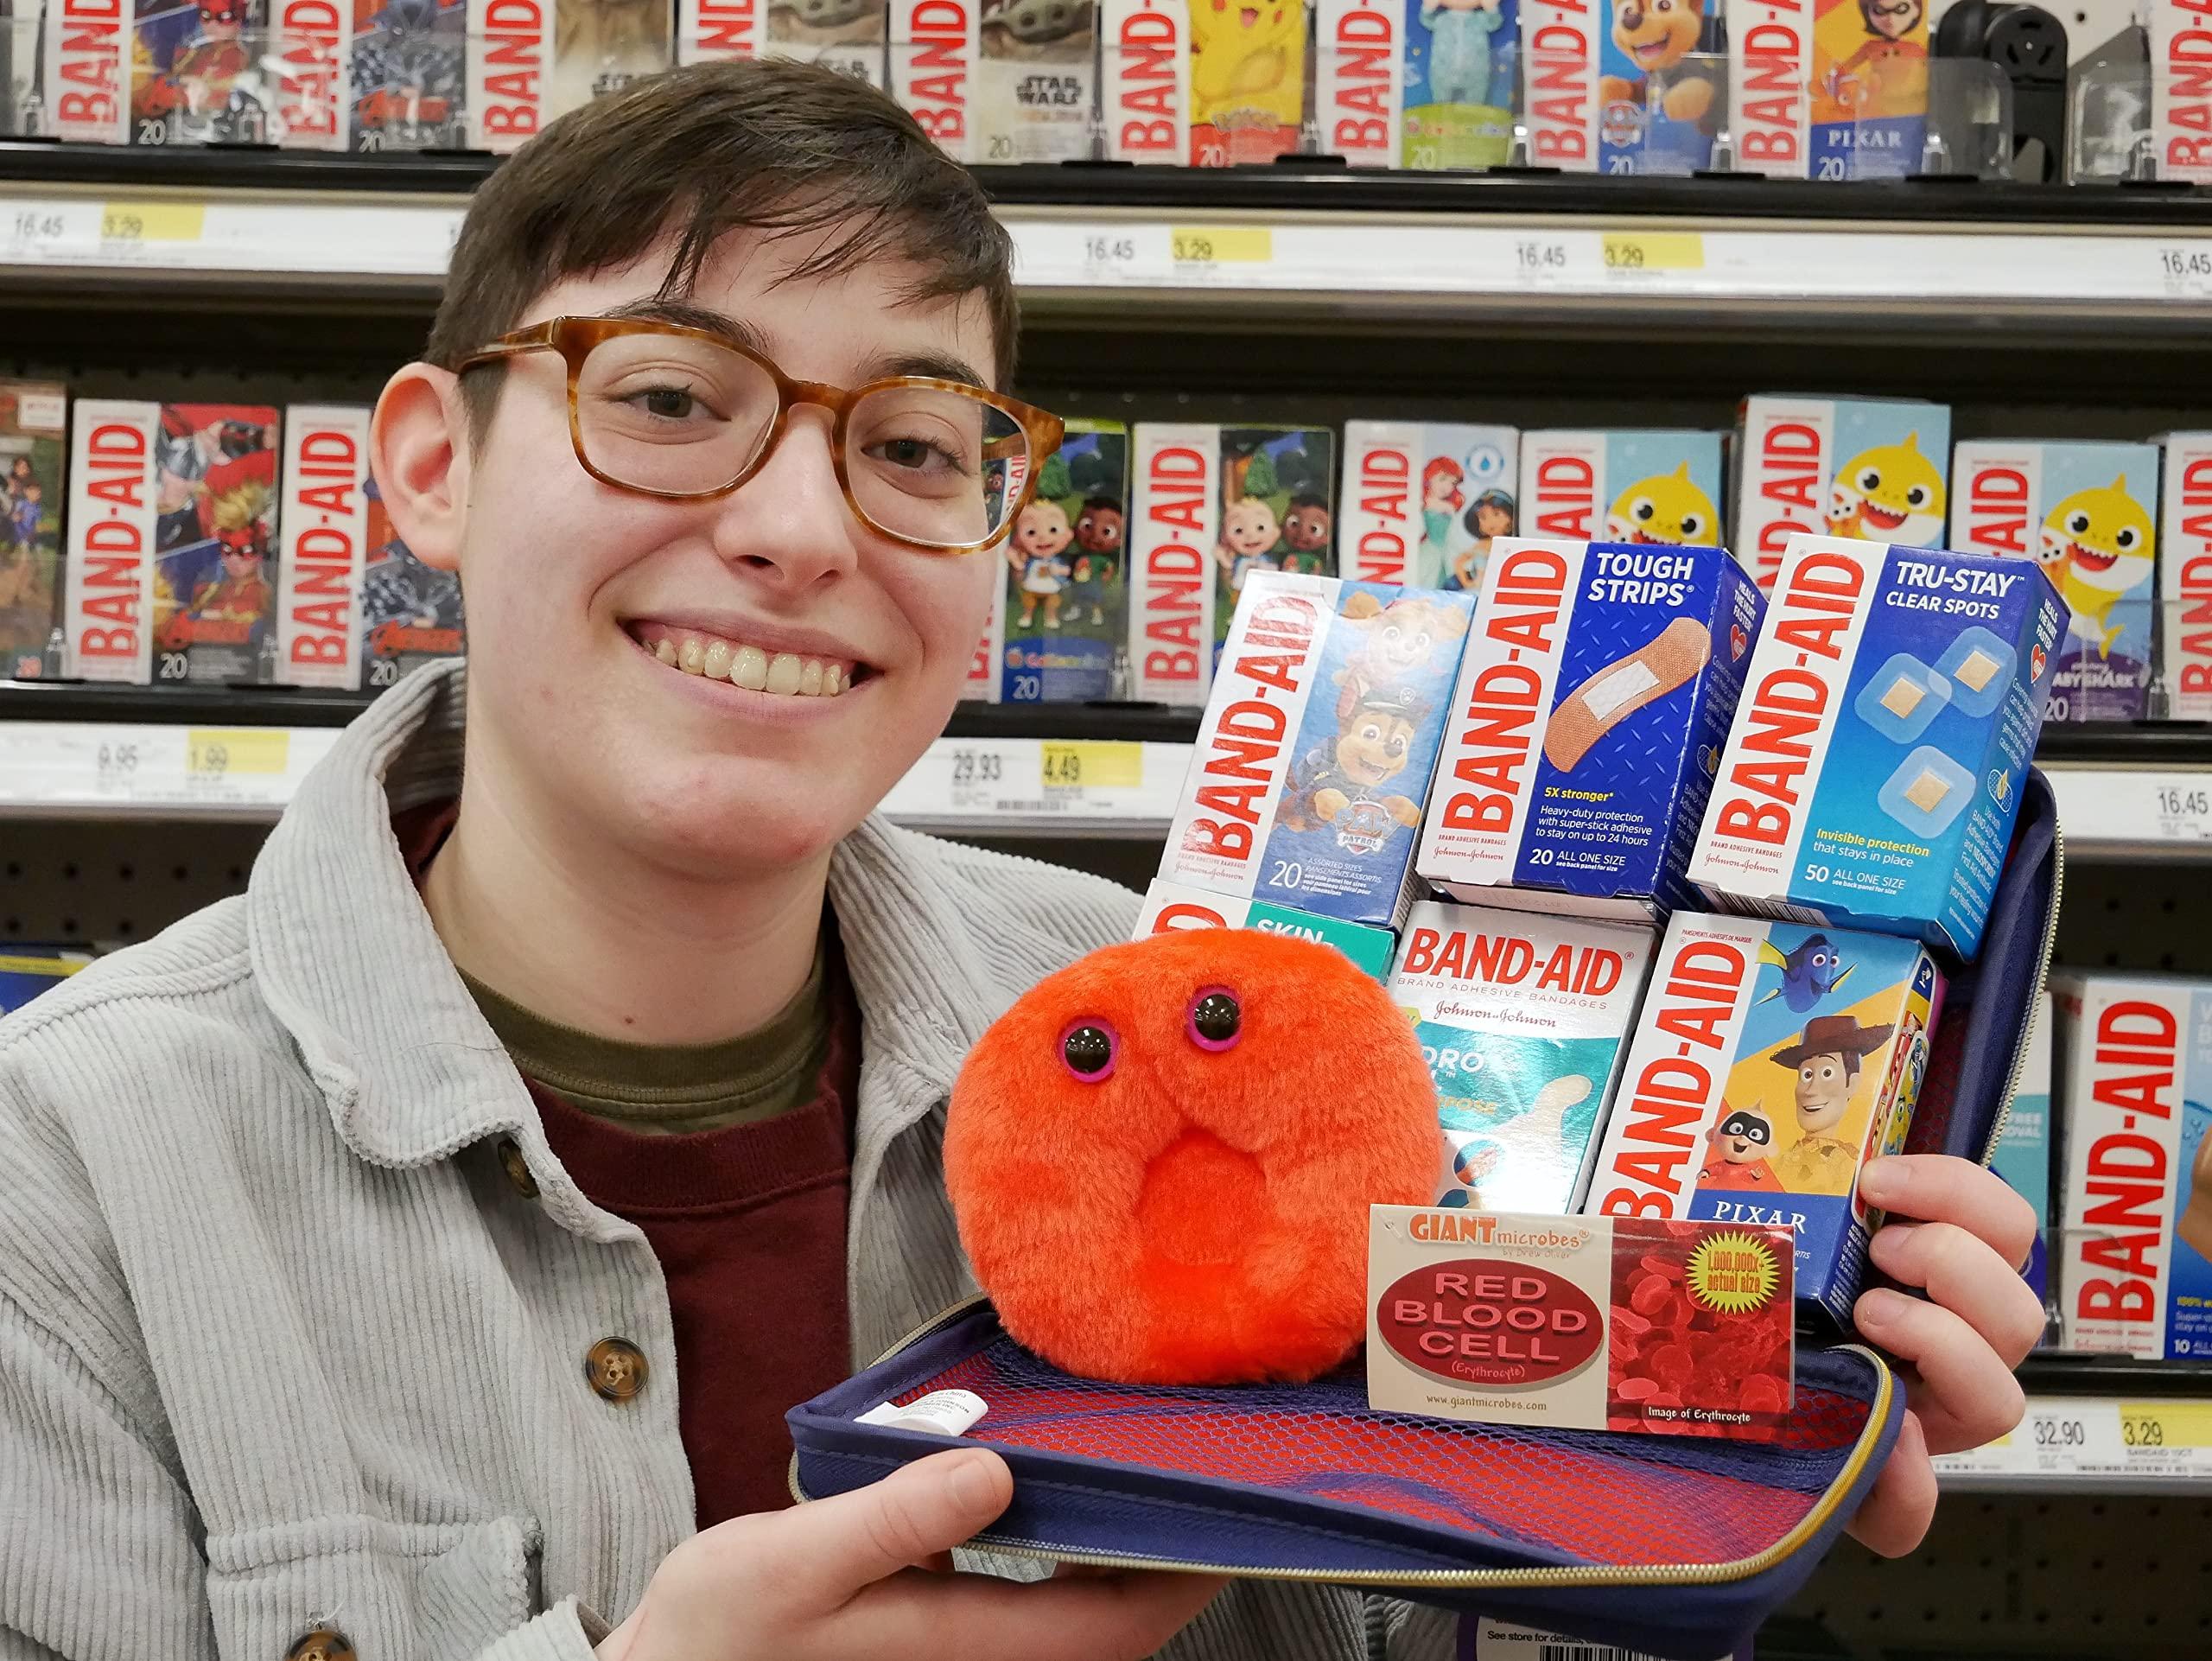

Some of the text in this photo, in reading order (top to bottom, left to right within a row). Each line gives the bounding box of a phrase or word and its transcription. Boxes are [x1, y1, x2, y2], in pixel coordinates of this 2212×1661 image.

[59, 0, 122, 124] BAND
[279, 1, 340, 137] BAND
[484, 1, 543, 136] BAND
[906, 0, 966, 139] BAND
[1120, 0, 1176, 150] BAND-
[1335, 0, 1393, 150] BAND-
[138, 119, 166, 145] 20
[1828, 129, 1903, 149] PIXAR
[1818, 156, 1843, 181] 20
[15, 213, 64, 239] 16.45
[103, 215, 143, 239] 3.29
[1086, 239, 1135, 261] 16.45
[1174, 242, 1213, 261] 3.29
[1517, 244, 1566, 268] 16.45
[1605, 246, 1644, 269] 3.29
[2163, 254, 2212, 275] 16.45
[80, 423, 148, 658] BAND-AID
[290, 432, 356, 665] BAND-AID
[1144, 447, 1206, 681] BAND-AID
[1596, 552, 1695, 581] TOUGH
[1885, 590, 2000, 620] CLEAR SPOTS
[160, 653, 188, 679] 20
[370, 659, 397, 686] 20
[1012, 675, 1040, 700] 20
[1442, 549, 1568, 834] BAND-AID
[1714, 551, 1866, 845] BAND-AID
[2044, 697, 2069, 722] 20
[1181, 595, 1319, 861] BAND-AID
[954, 754, 1001, 780] 29.93
[1044, 754, 1080, 780] 4.49
[1544, 786, 1559, 798] 5X
[2158, 791, 2209, 815] 16.45
[1538, 816, 1653, 836] with super-stick adhesive
[1541, 805, 1643, 824] Heavy-duty protection
[1342, 835, 1378, 848] PATROL
[1455, 835, 1480, 844] ADHESIVE
[1480, 837, 1507, 846] BANDAGES
[1535, 827, 1649, 846] to stay on up to 24 hours
[1815, 827, 1930, 857] Invisible protection
[1529, 848, 1626, 866] 20 ALL ONE SIZE
[1710, 840, 1783, 859] BRAND ADHESIVE BANDAGES
[1813, 842, 1914, 868] that stays in place
[1269, 860, 1302, 888] 20
[1307, 856, 1363, 872] ASSORTED SIZES
[1580, 862, 1596, 871] panel
[1804, 863, 1906, 889] 50 ALL ONE SIZE
[1841, 880, 1858, 888] back
[1857, 882, 1874, 893] panel
[1873, 885, 1885, 894] for
[1884, 887, 1897, 895] size
[1681, 928, 1709, 939] PANSEMENTS
[1397, 977, 1608, 1010] BRAND ADHESIVE BANDAGES
[1421, 1046, 1484, 1072] DRO
[1600, 940, 1746, 1218] BAND-AID
[2075, 1000, 2177, 1325] BAND-AID
[1712, 1200, 1807, 1234] PIXAR
[1503, 1249, 1513, 1257] by
[1516, 1249, 1541, 1258] Drew
[1434, 1272, 1548, 1301] RED
[1707, 1271, 1761, 1294] actual size
[1394, 1299, 1587, 1333] BLOOD
[1418, 1331, 1560, 1362] CELL
[2173, 1339, 2190, 1354] 10
[1451, 1359, 1526, 1382] (Erythrocyte)
[1426, 1394, 1548, 1411] www.giantmicrobes.com
[1648, 1406, 1751, 1423] Image of Erythrocyte
[2033, 1421, 2085, 1446] 32.90
[2123, 1421, 2164, 1446] 3.29
[1487, 1630, 1505, 1640] See
[1509, 1631, 1532, 1641] store
[1535, 1632, 1548, 1642] for
